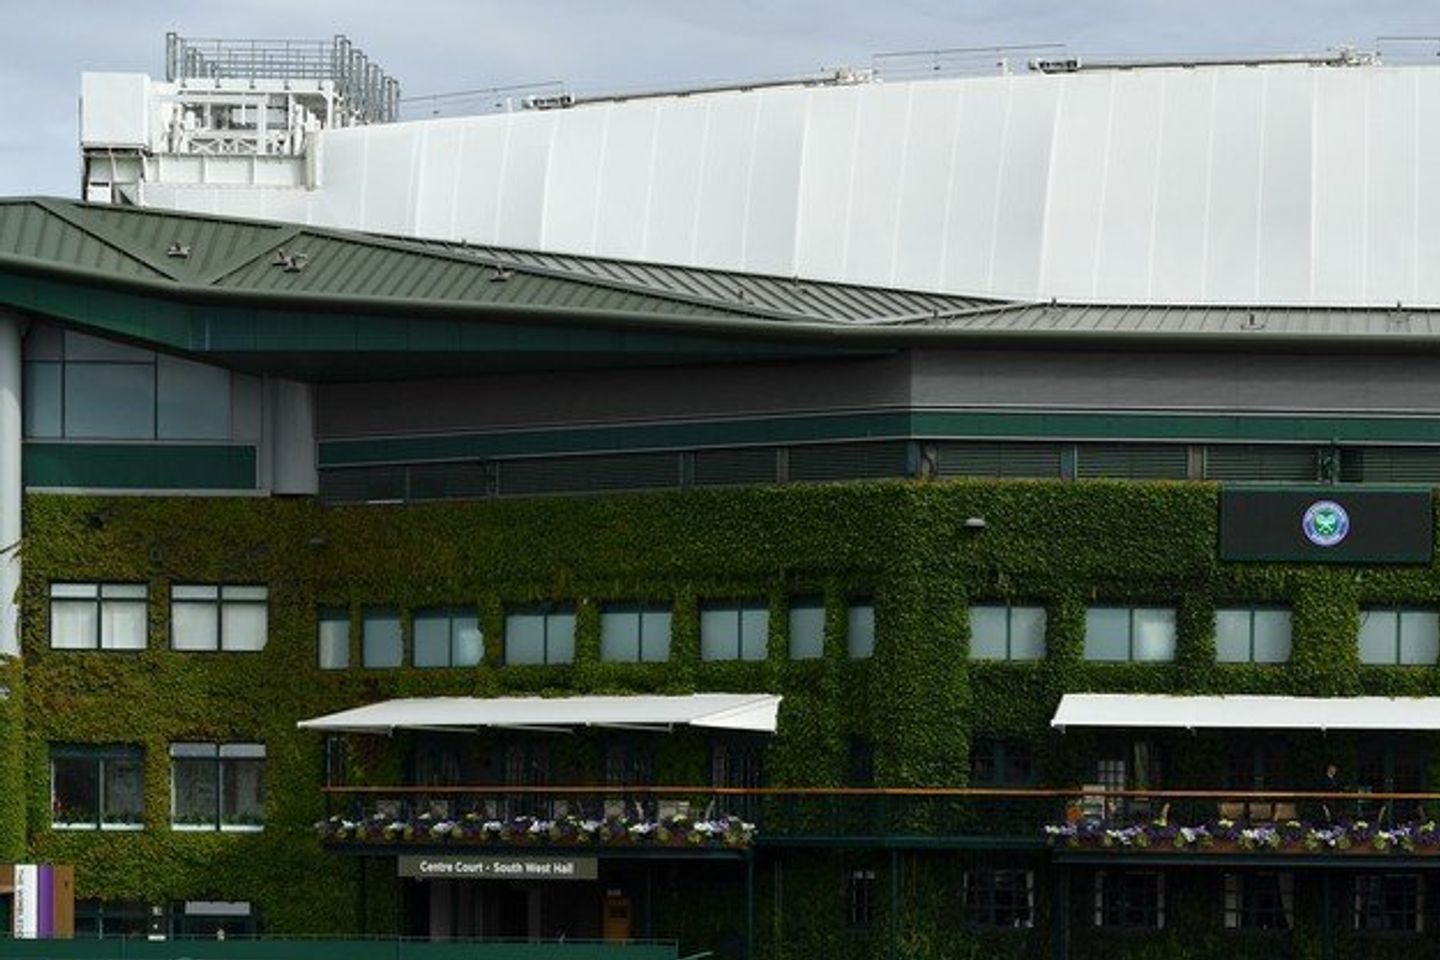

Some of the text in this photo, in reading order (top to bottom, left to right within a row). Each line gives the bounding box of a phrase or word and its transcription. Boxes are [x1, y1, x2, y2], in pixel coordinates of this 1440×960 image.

[419, 860, 574, 875] Centre Court South West Hall
